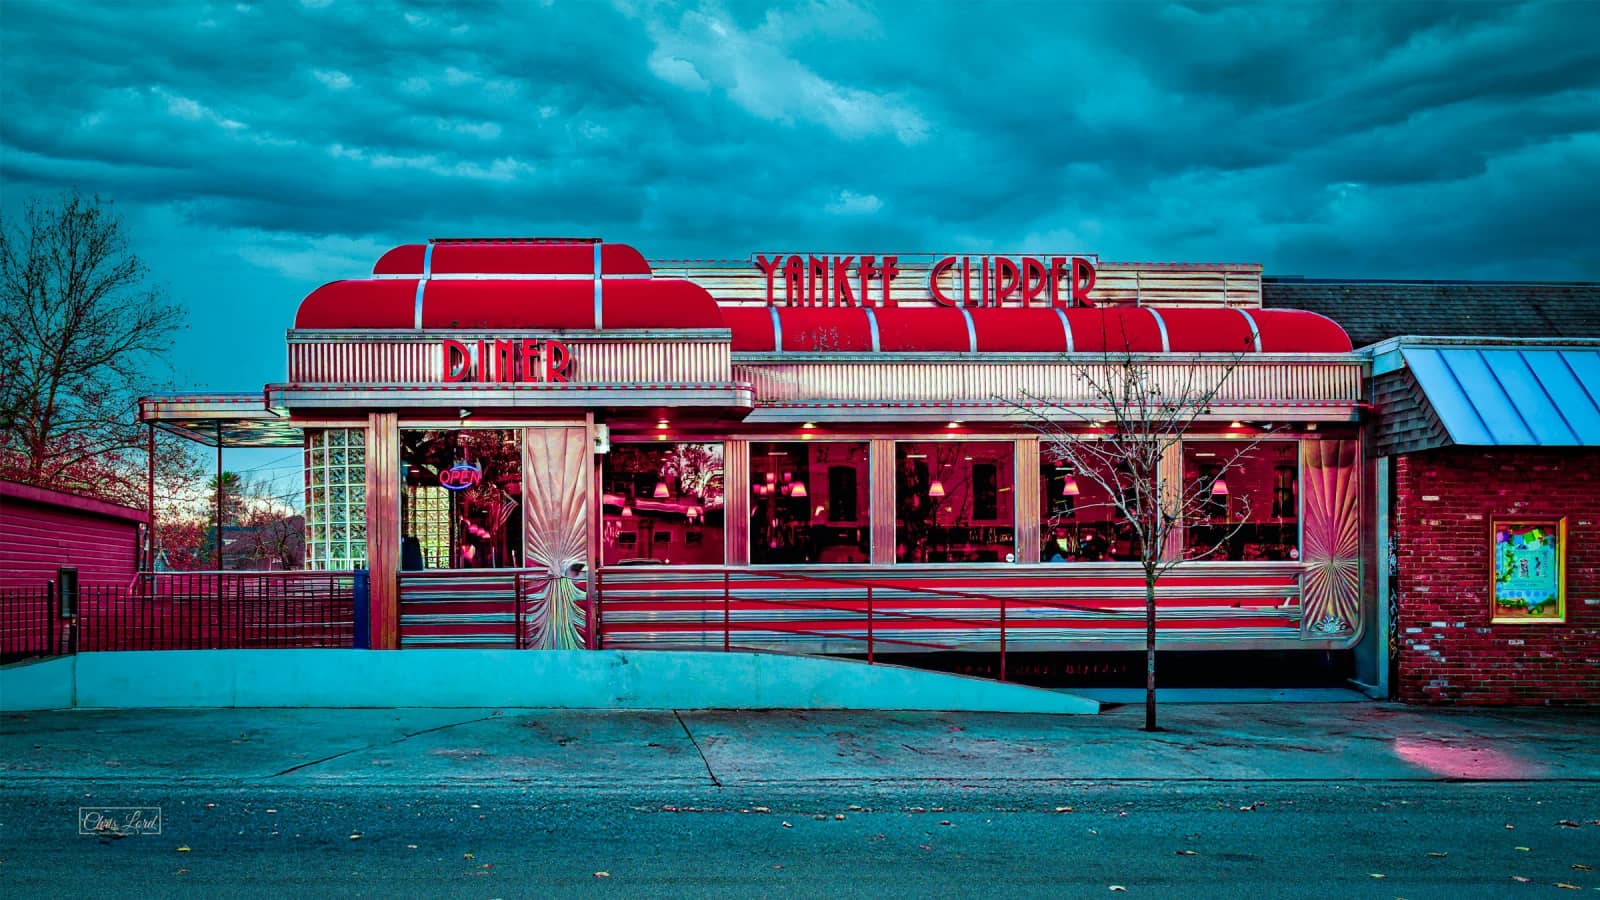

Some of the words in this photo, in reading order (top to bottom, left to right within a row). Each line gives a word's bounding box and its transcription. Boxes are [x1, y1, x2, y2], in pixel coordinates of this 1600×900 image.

[756, 254, 898, 307] YANKEE
[929, 255, 1096, 307] CLIPPER
[443, 338, 569, 382] DINER
[439, 469, 482, 486] OPEN
